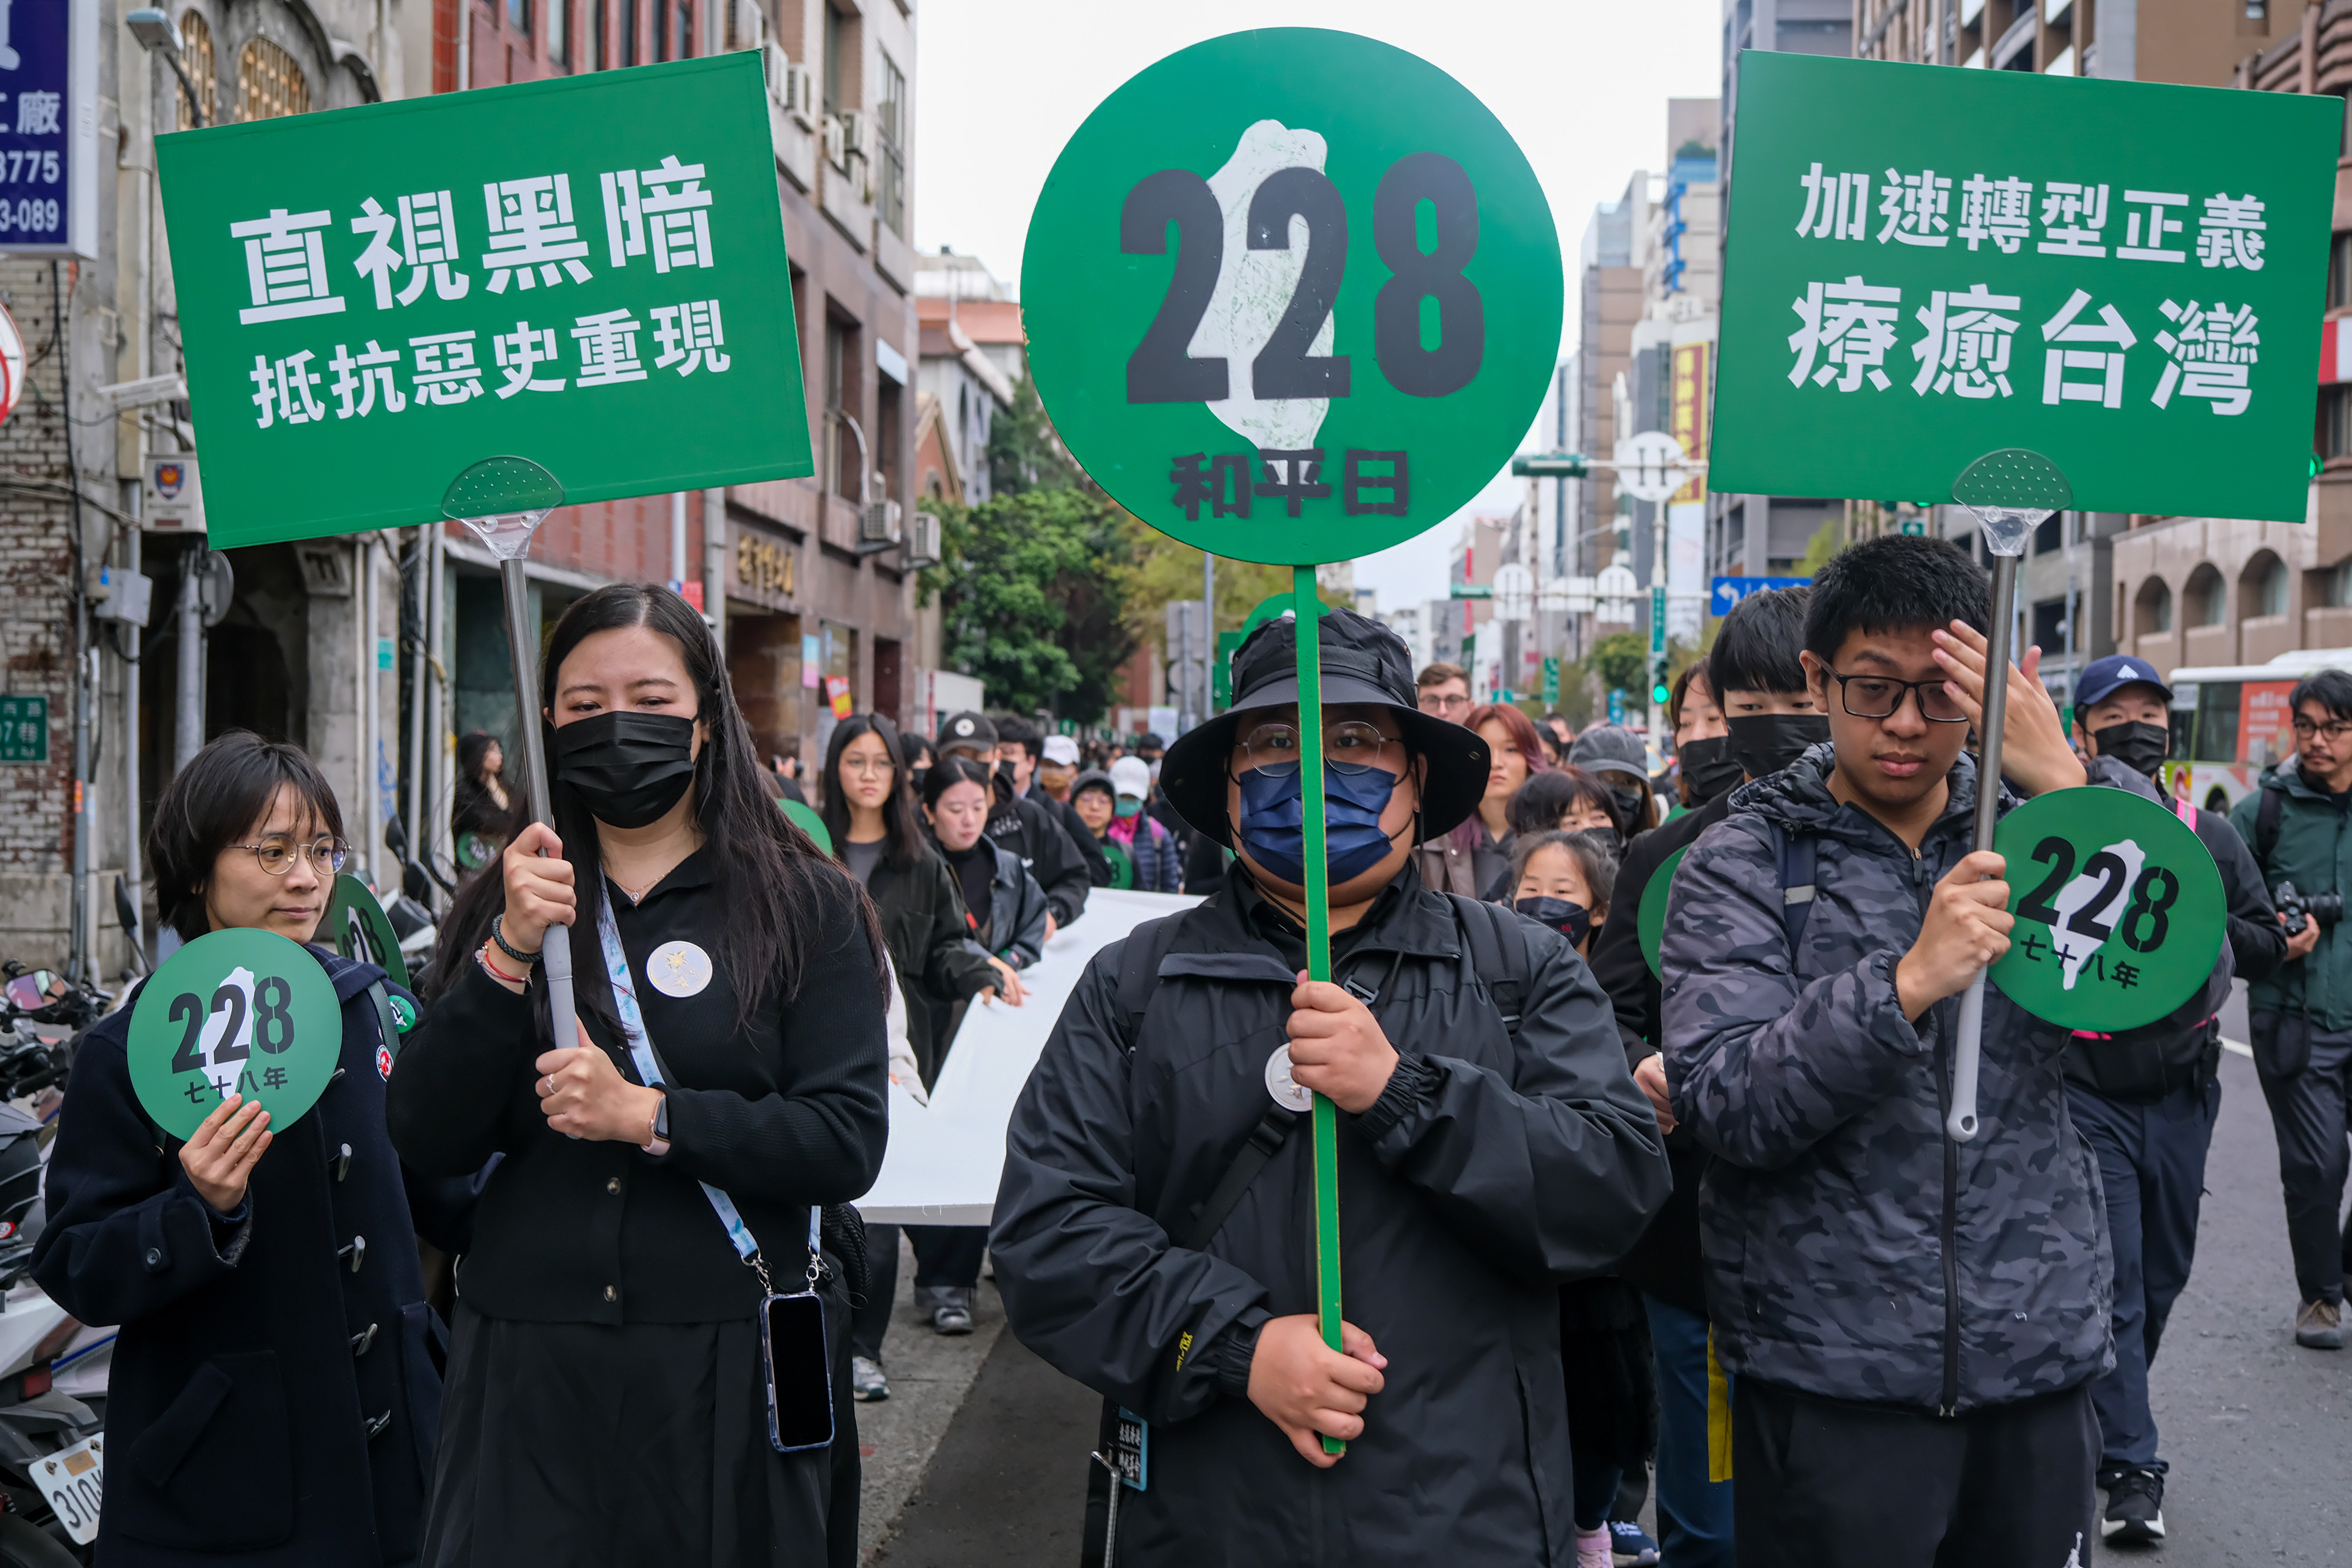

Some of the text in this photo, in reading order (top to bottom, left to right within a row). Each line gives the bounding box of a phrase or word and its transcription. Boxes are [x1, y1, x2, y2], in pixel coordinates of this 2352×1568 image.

[0, 89, 61, 135] 廠
[230, 155, 713, 325] 直視黑暗
[1796, 163, 2266, 271] 加速轉型正義
[1120, 152, 1485, 403] 228
[250, 300, 730, 428] 抵抗惡史重現
[1788, 276, 2259, 416] 療癒台灣
[1171, 447, 1408, 520] 和平日
[2015, 836, 2179, 953] 228
[2020, 934, 2140, 989] 七十八年
[169, 977, 294, 1074] 228
[184, 1067, 288, 1103] 七十八年
